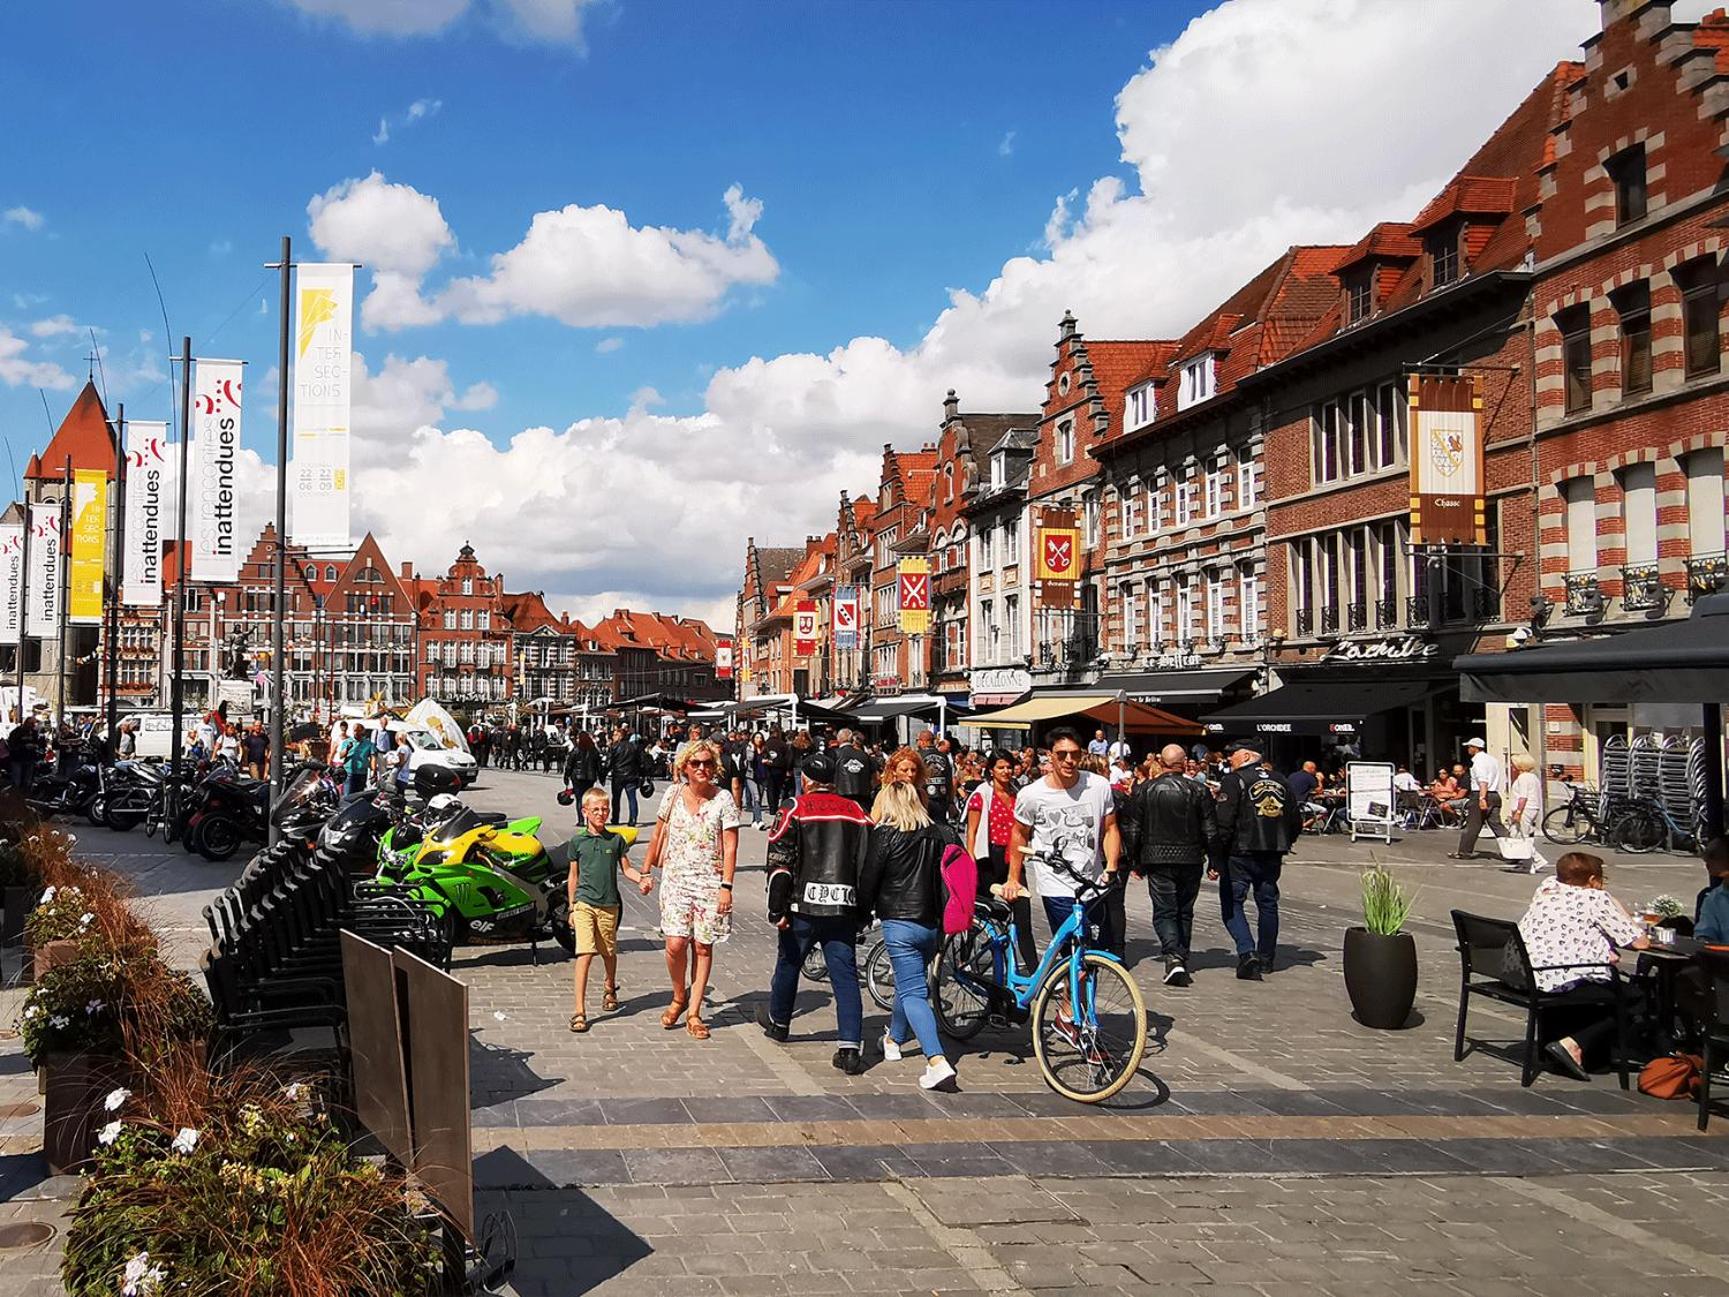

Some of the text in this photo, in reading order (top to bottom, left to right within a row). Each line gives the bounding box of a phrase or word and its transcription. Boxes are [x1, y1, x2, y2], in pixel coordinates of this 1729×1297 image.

[298, 384, 341, 398] TIONS
[213, 418, 234, 555] inattendues
[140, 470, 160, 584] inattendues
[6, 555, 19, 630] inattendues
[41, 539, 56, 621] inattendues
[470, 919, 495, 933] elf
